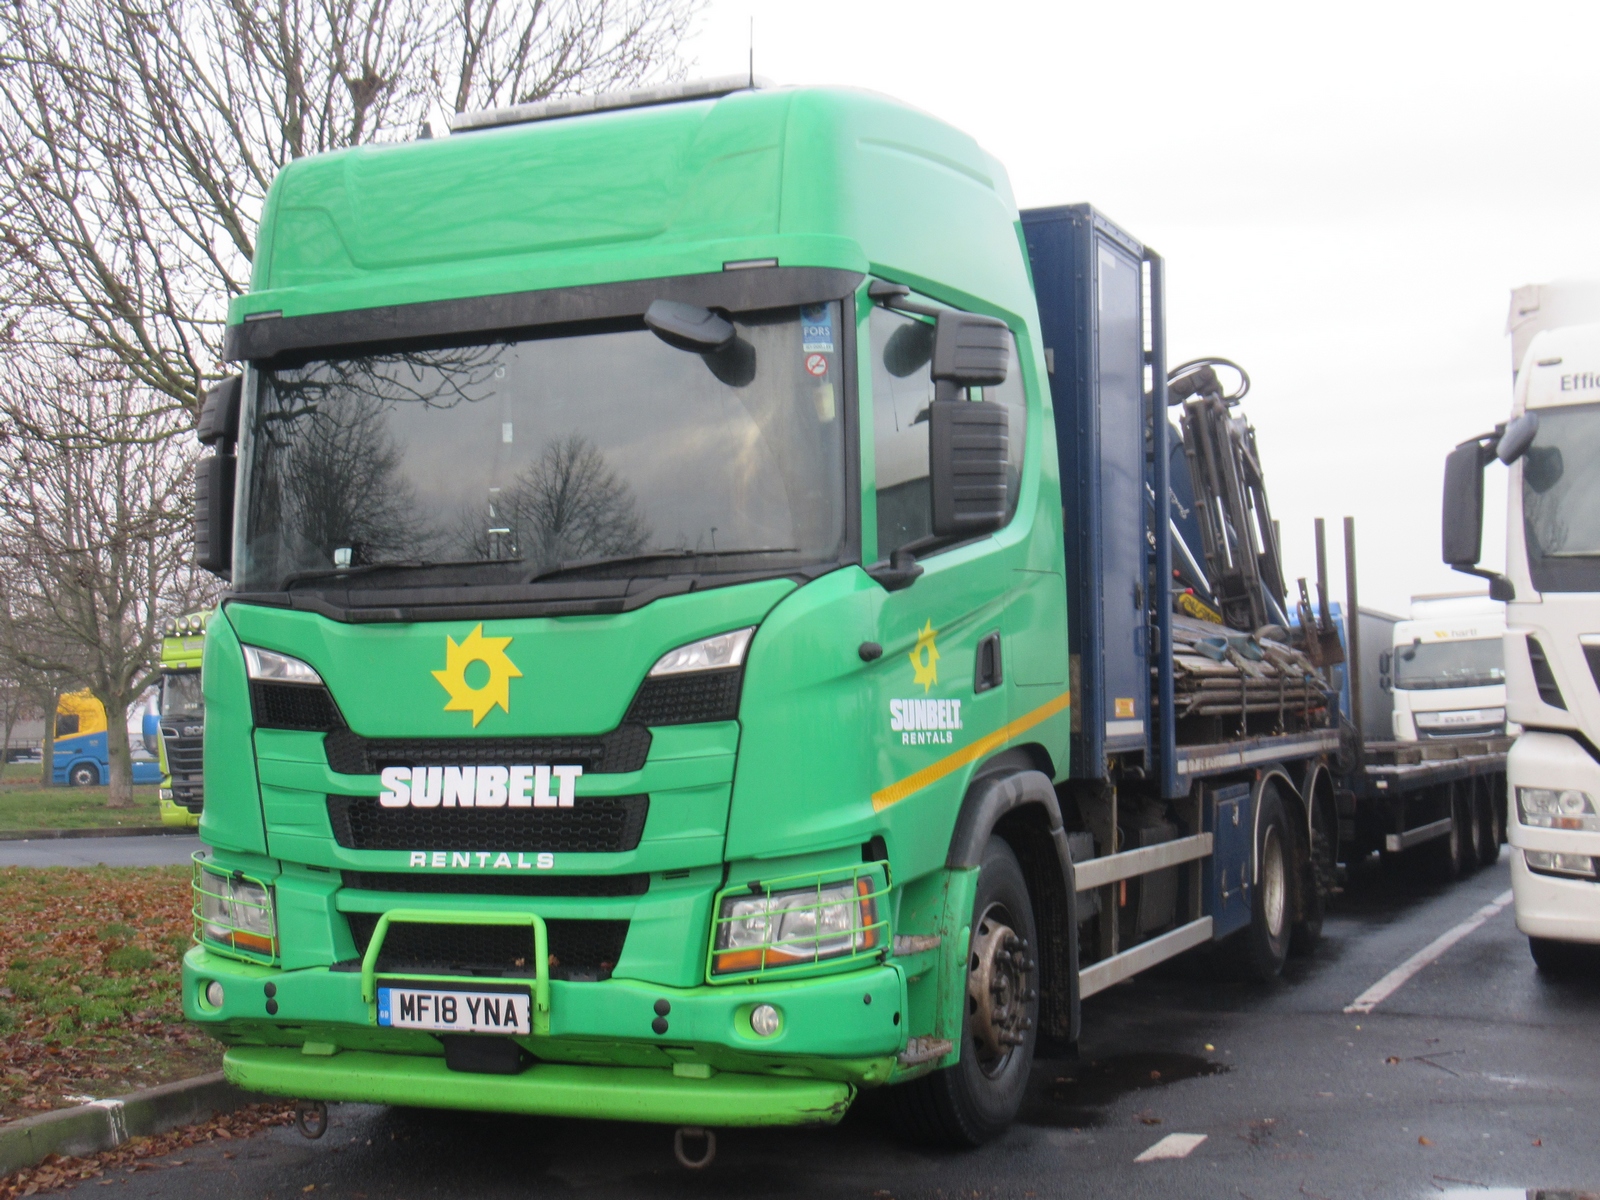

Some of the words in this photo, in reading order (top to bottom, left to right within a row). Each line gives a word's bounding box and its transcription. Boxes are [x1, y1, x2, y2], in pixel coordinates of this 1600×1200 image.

[803, 326, 830, 336] FORS
[890, 699, 962, 731] SUNBELT
[902, 731, 952, 745] RENTALS
[380, 765, 583, 807] SUNBELT
[410, 852, 554, 869] RENTALS
[400, 993, 457, 1023] MF18
[466, 997, 518, 1027] YNA
